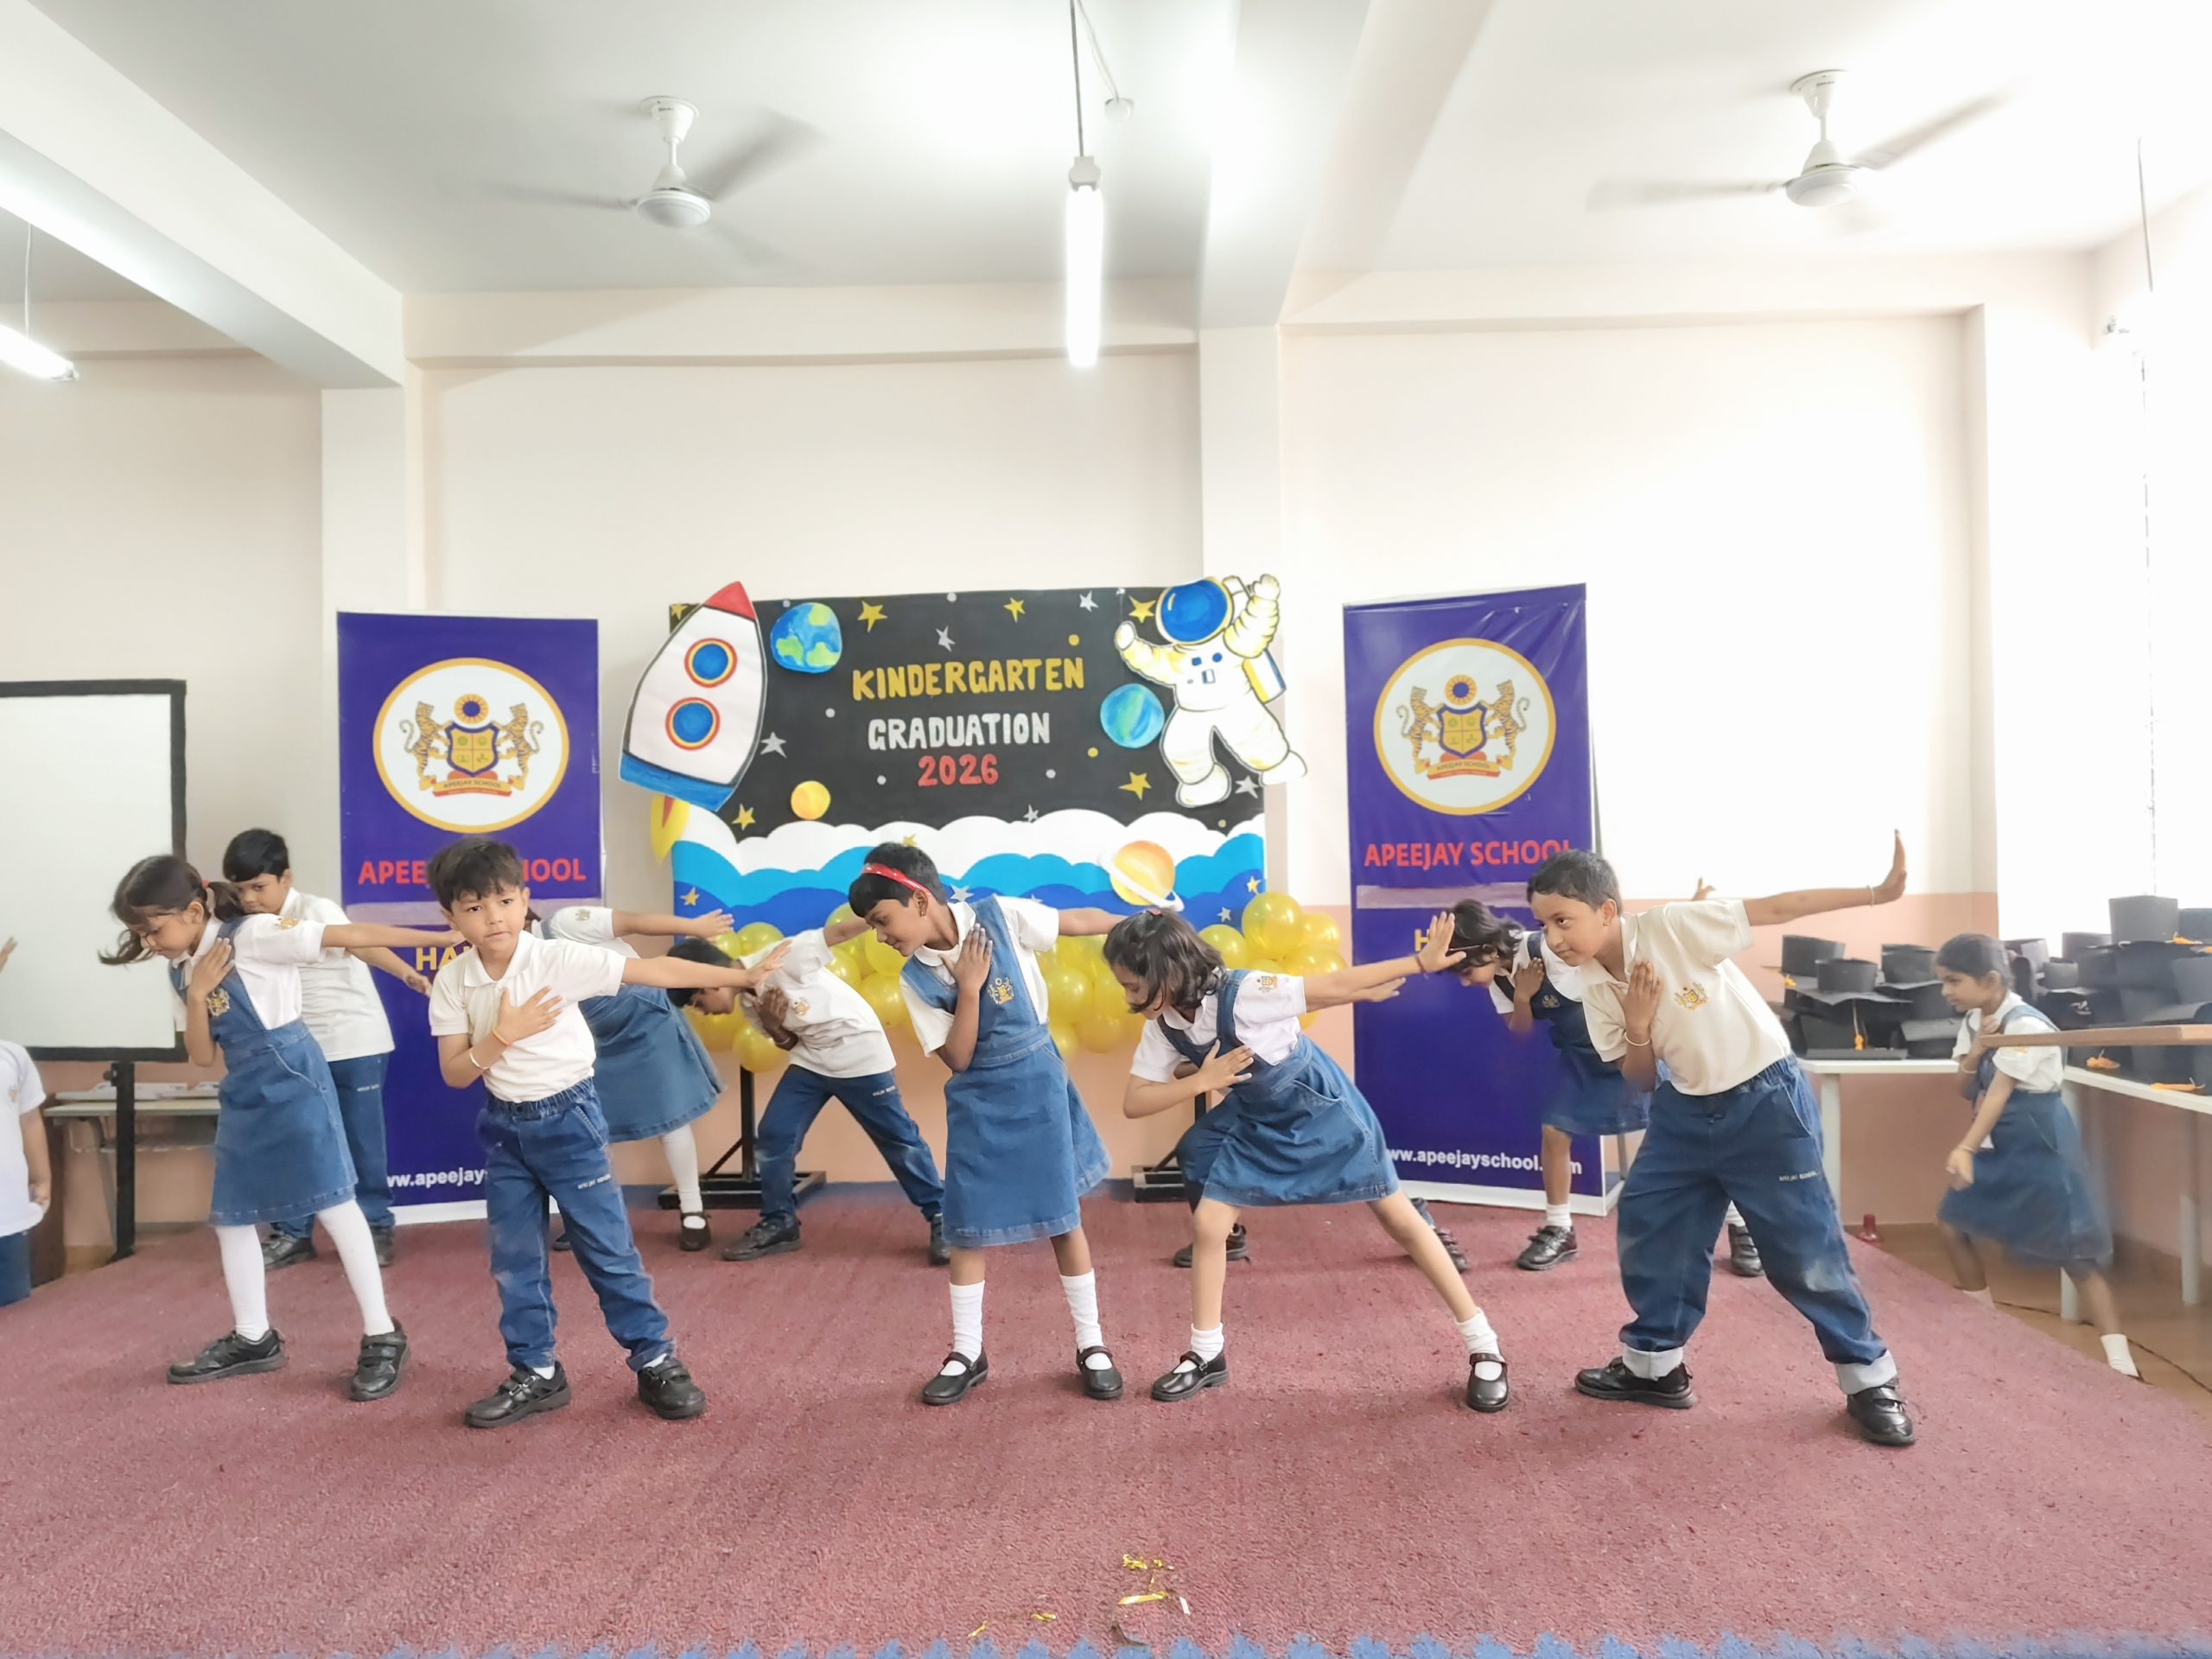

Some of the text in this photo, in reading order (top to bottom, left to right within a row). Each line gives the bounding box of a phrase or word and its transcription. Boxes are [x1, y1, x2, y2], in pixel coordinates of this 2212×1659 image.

[852, 657, 1084, 701] KINDERGARTEN
[868, 712, 1050, 750] GRADUATION
[918, 753, 999, 786] 2026
[1364, 842, 1465, 871] APEEJAY
[358, 861, 430, 886] APEE
